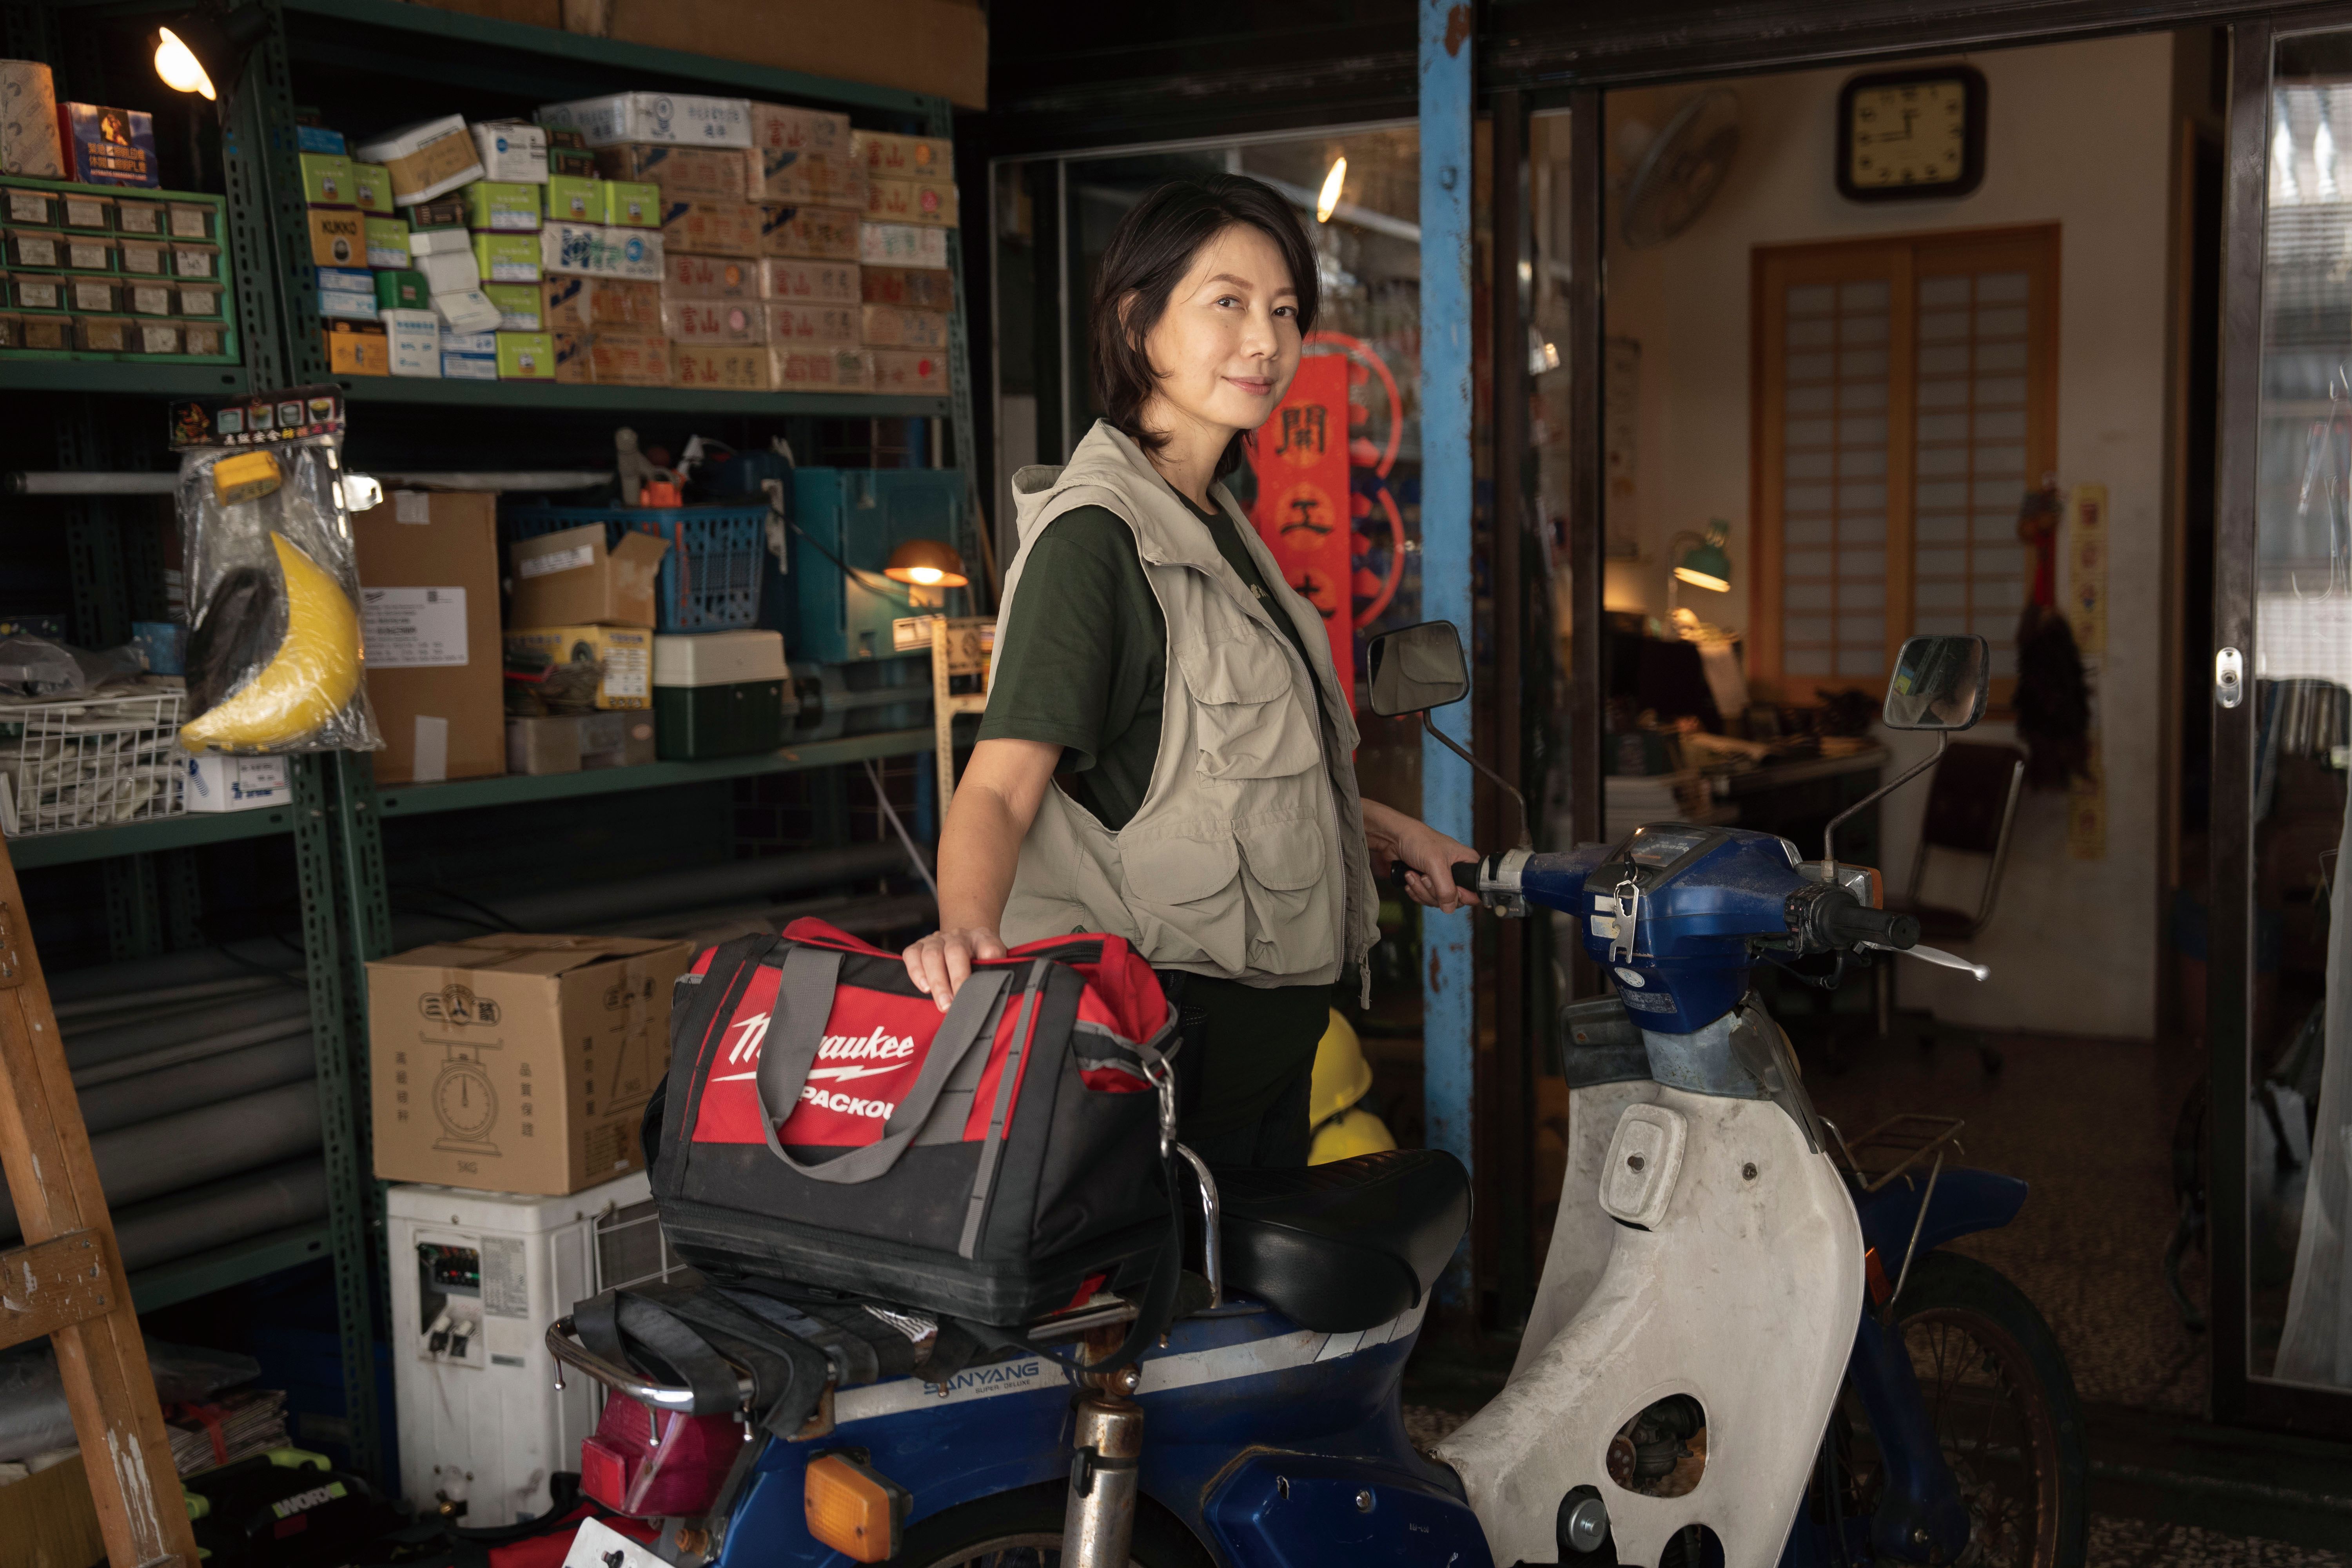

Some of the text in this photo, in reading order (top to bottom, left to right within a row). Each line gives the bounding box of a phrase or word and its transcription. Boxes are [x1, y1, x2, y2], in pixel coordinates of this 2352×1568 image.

[729, 1011, 915, 1065] Maukee
[976, 1379, 1030, 1394] SUPER DELUXE
[275, 1485, 336, 1515] WORX
